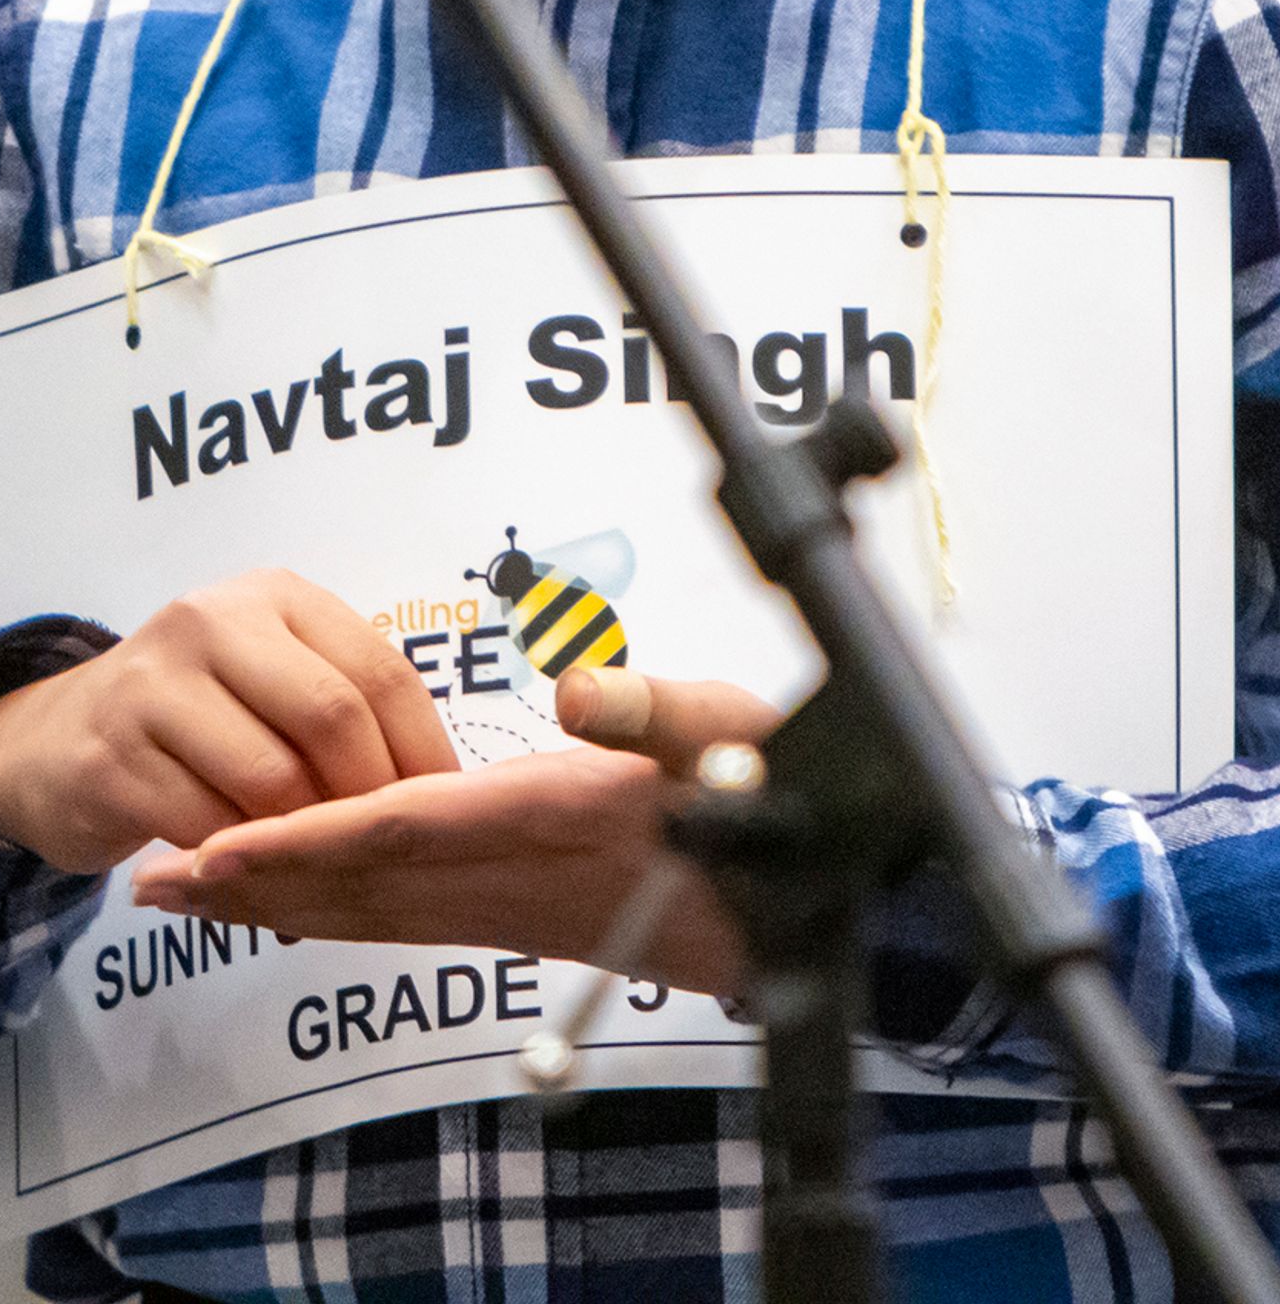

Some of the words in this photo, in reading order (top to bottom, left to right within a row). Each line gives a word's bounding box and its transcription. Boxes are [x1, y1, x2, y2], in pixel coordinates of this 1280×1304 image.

[132, 326, 472, 501] Navtaj
[372, 598, 479, 634] elling
[403, 624, 511, 699] EE
[95, 916, 303, 1011] SUNNY
[287, 957, 543, 1062] GRADE
